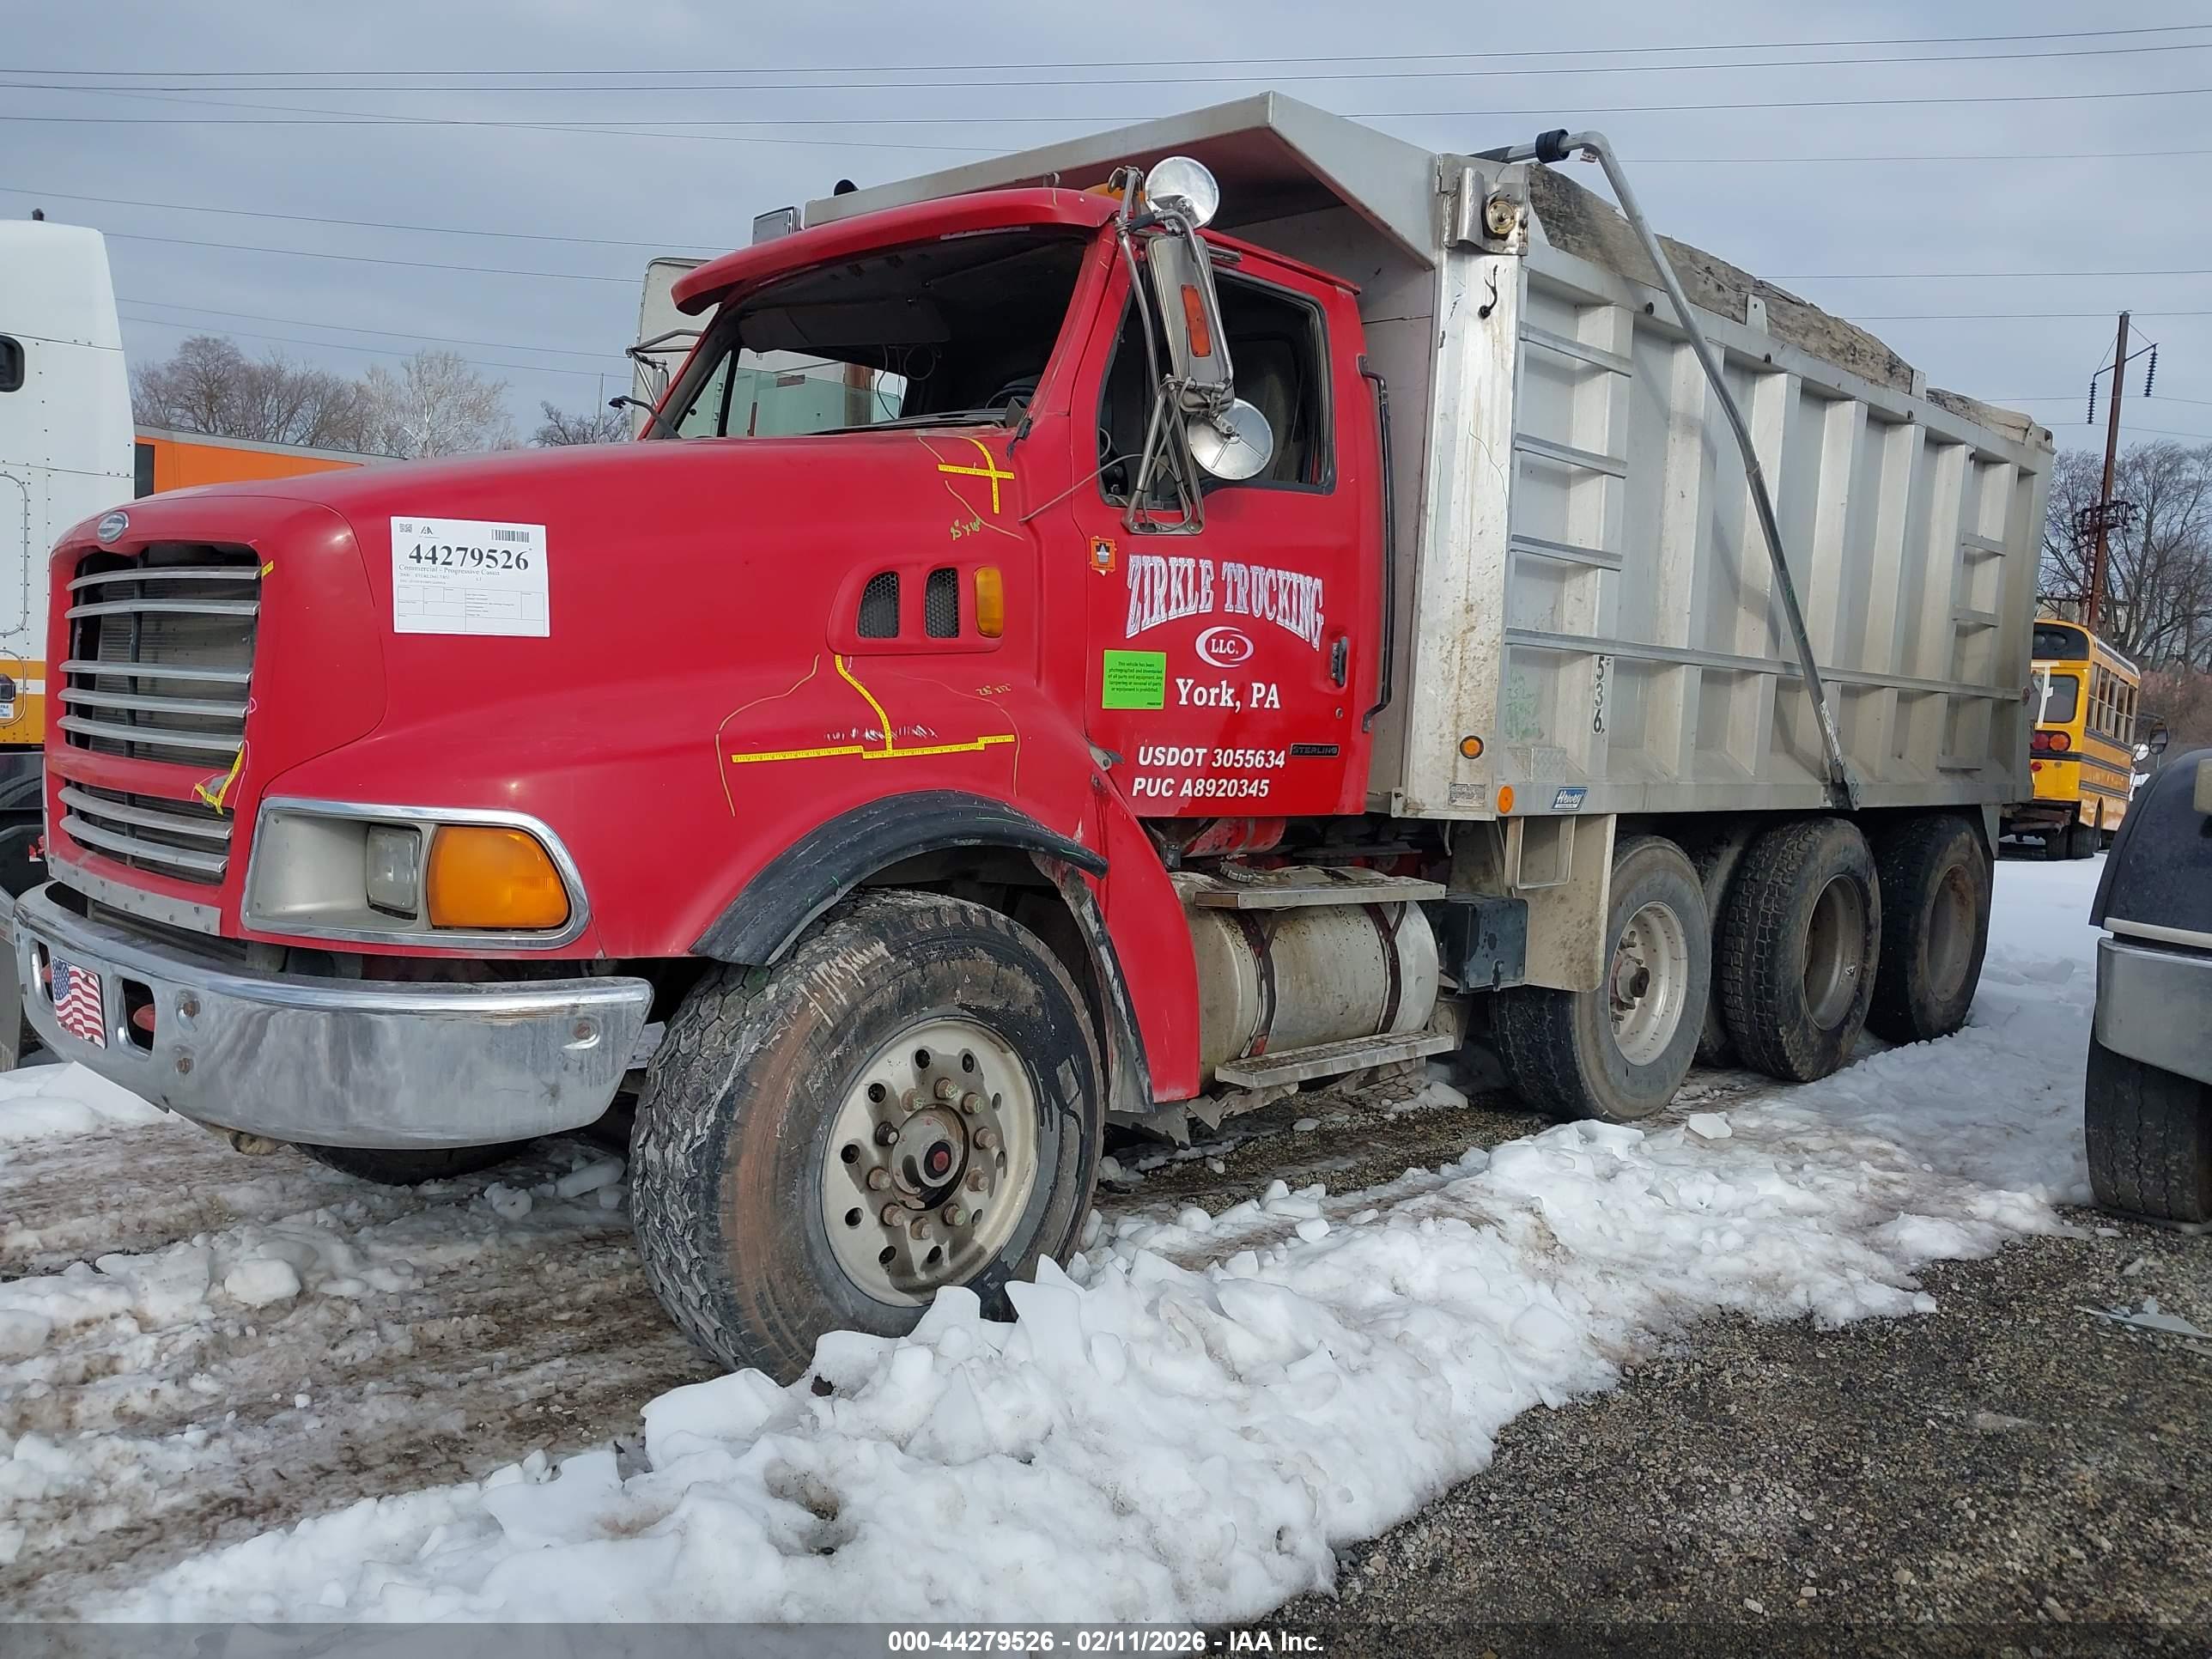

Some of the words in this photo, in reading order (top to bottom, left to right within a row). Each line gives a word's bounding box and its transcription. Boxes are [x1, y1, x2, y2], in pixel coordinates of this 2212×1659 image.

[409, 544, 529, 570] 44279526
[398, 564, 437, 573] Commercial
[444, 568, 480, 576] Progressive
[1125, 555, 1214, 639] ZIRKLE
[1222, 562, 1324, 652] TRUCKING
[1211, 638, 1239, 654] LLC.
[1176, 678, 1241, 714] York,
[1249, 683, 1280, 709] PA
[1138, 745, 1207, 767] USDOT
[1211, 748, 1285, 769] 3055634
[1292, 745, 1338, 754] STERLING
[1132, 777, 1175, 798] PUC
[1179, 777, 1270, 798] A8920345
